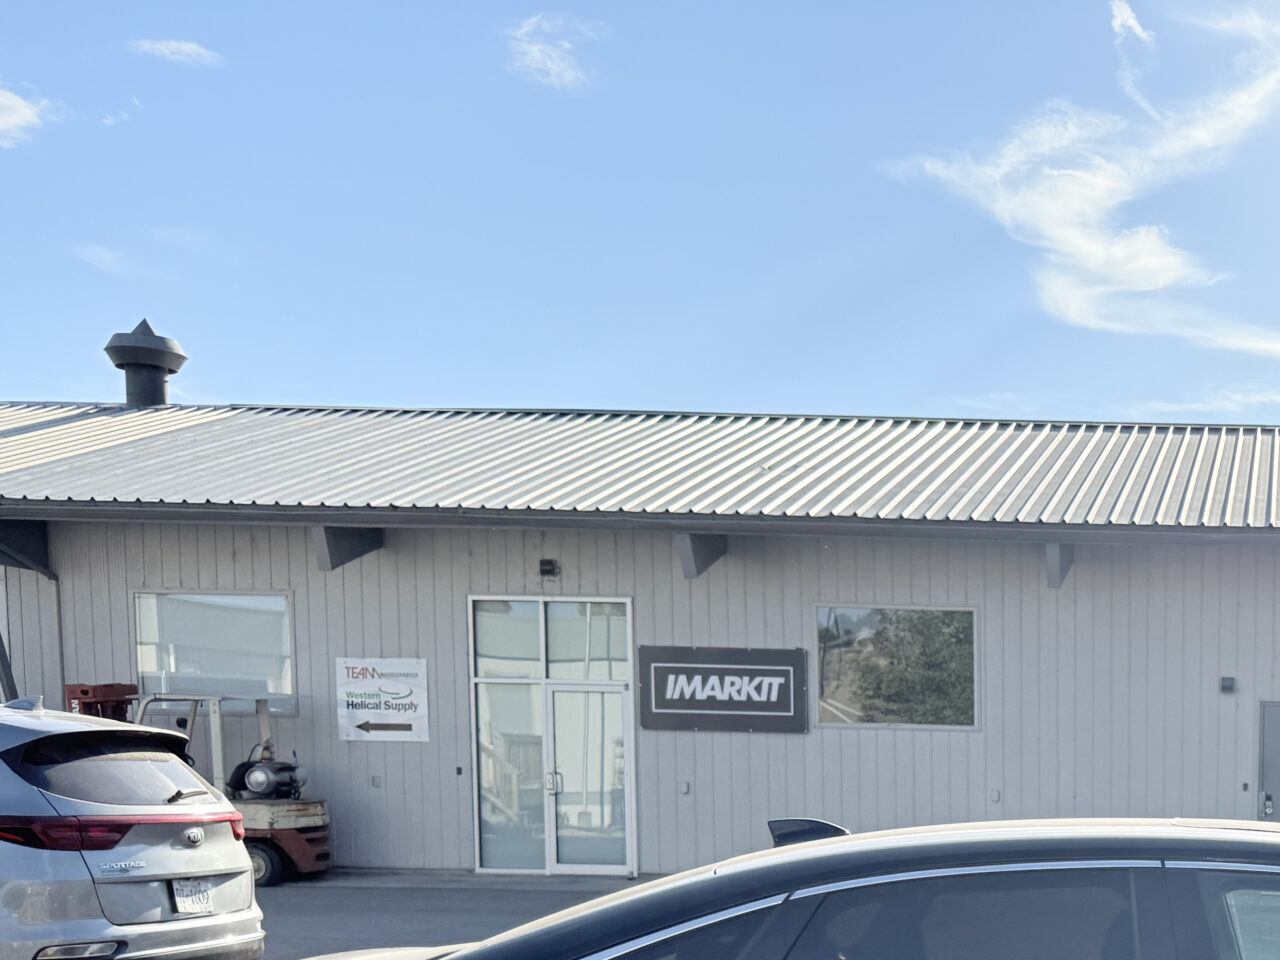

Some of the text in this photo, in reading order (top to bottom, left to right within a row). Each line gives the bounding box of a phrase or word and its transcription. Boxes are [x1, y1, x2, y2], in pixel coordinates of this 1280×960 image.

[345, 666, 381, 679] TEAM
[666, 674, 785, 702] IMARKIT
[346, 691, 381, 700] Western
[346, 701, 418, 712] Helical Supply
